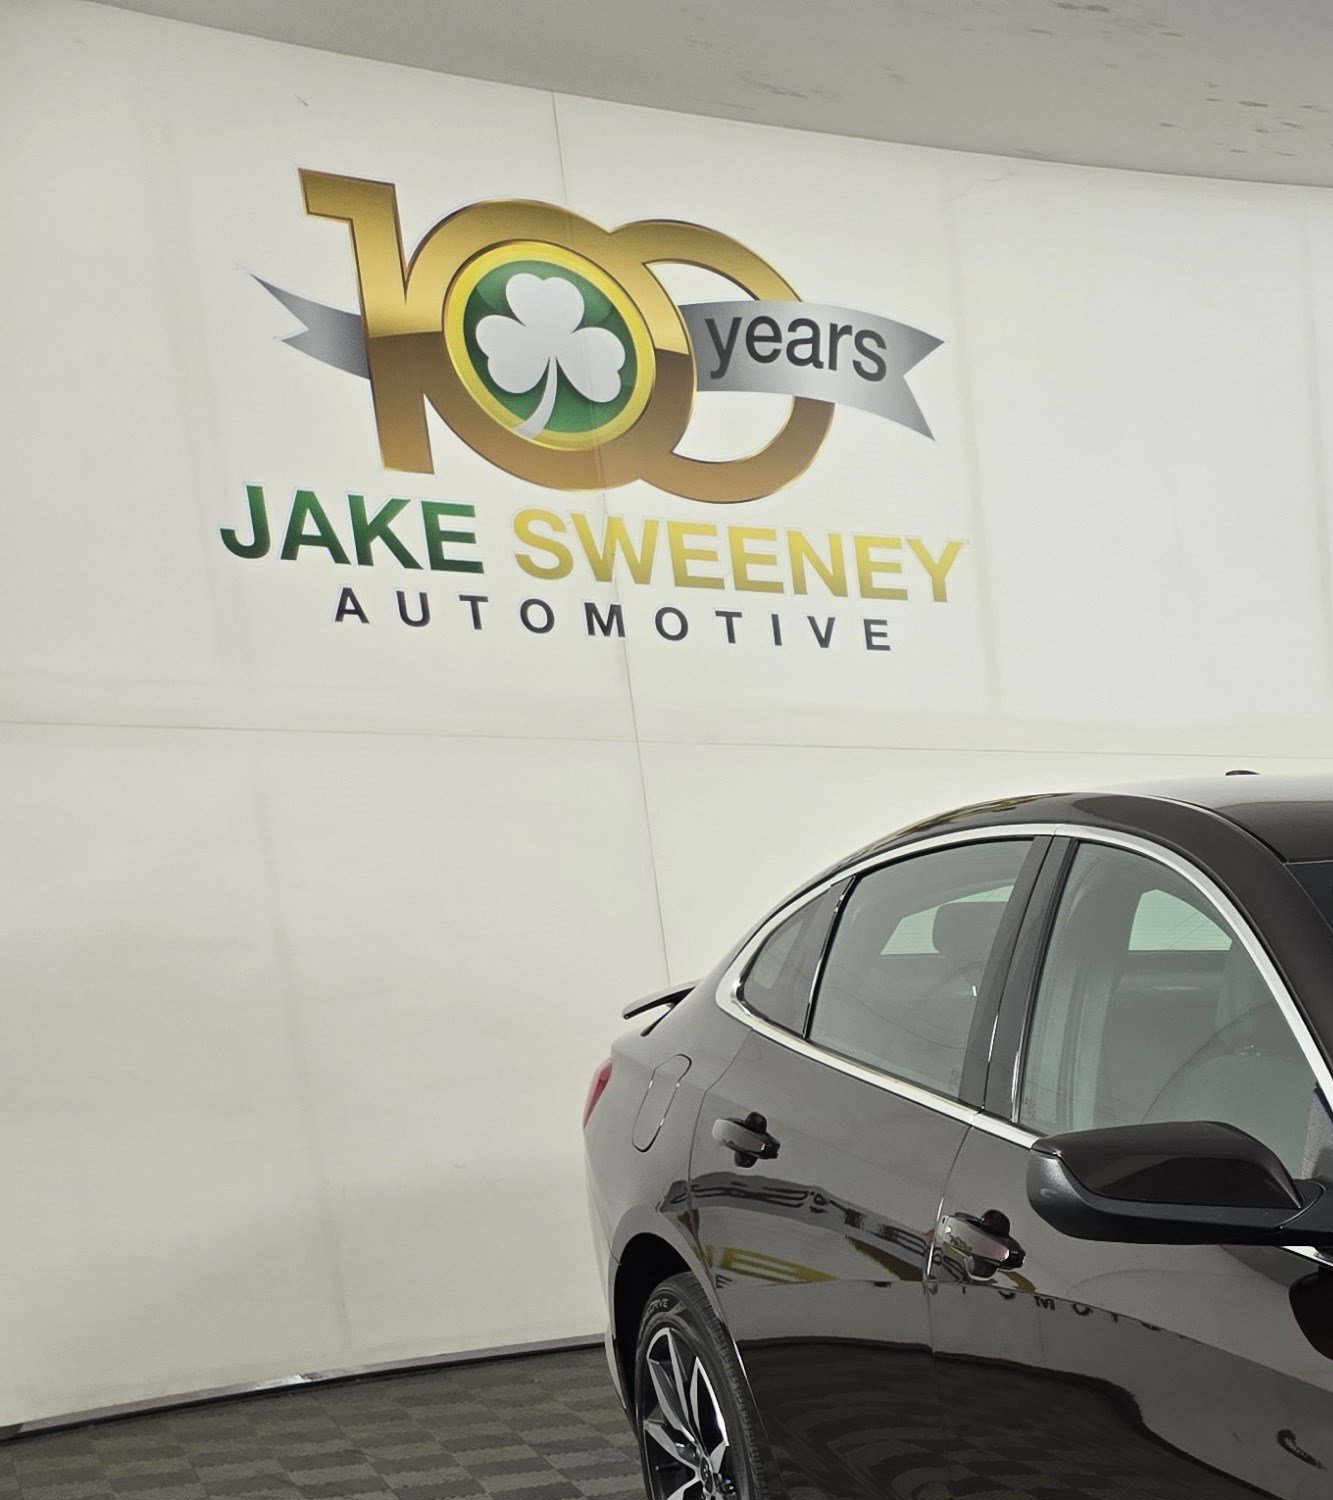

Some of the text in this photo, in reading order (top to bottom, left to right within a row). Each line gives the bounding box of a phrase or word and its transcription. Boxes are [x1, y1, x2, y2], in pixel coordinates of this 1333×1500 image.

[297, 167, 888, 504] 100 years
[220, 485, 966, 603] JAKE SWEENEY
[334, 587, 892, 651] AUTOMOTIVE
